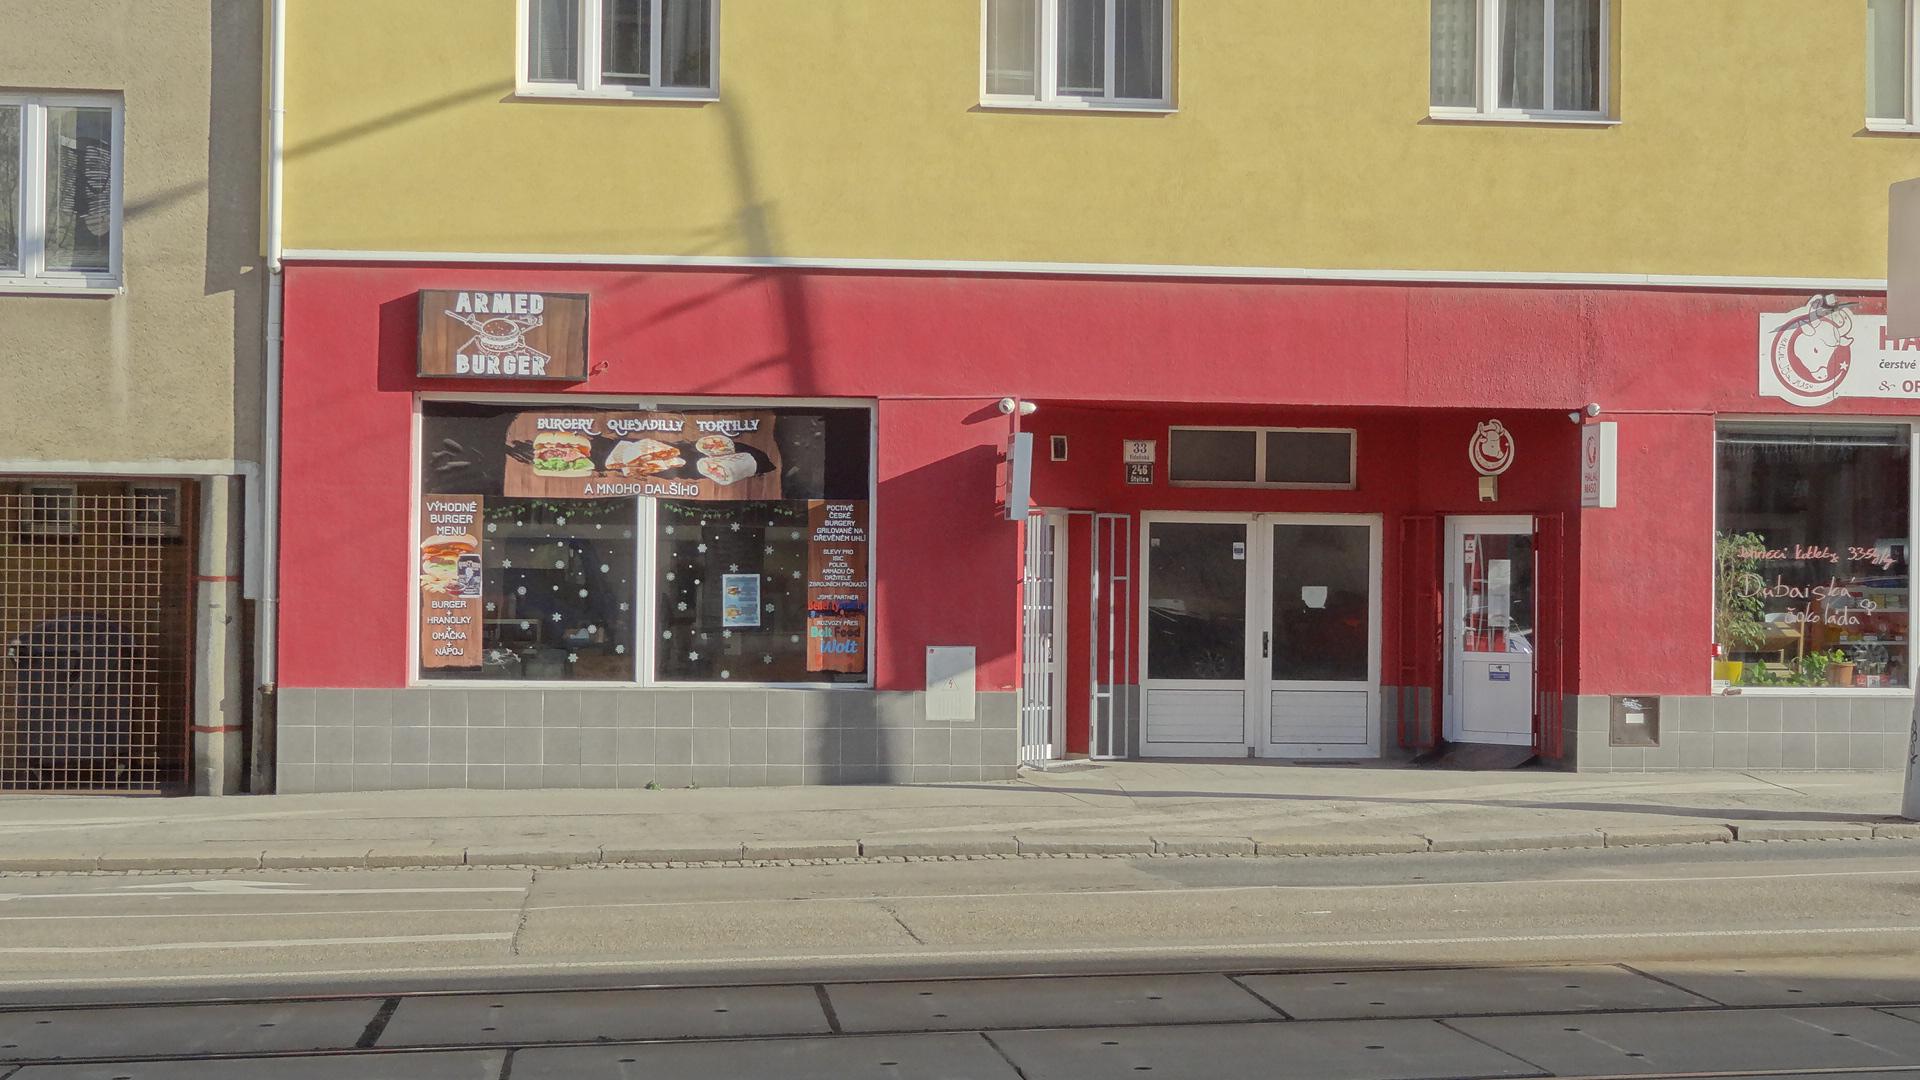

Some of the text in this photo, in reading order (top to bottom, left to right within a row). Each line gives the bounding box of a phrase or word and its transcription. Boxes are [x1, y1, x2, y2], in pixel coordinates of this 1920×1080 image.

[456, 292, 545, 315] ARMED
[456, 354, 546, 376] BURGER
[1879, 359, 1917, 369] čerstvé
[537, 418, 760, 437] BURGERY QUESADILLY TORTILLY
[1133, 443, 1147, 453] 33
[1131, 465, 1148, 475] 246
[584, 481, 699, 496] A MNOHO DALŠÍHO
[426, 501, 477, 512] VÝHODNÉ
[430, 514, 473, 524] BURGER
[829, 511, 852, 519] ČESKÉ
[436, 526, 467, 535] MENU
[432, 600, 467, 608] BURGER
[427, 616, 471, 624] HRANOLKY
[432, 630, 467, 640] OMÁČKA
[811, 626, 833, 638] Bolt
[435, 646, 464, 656] NÁPOJ
[821, 639, 858, 654] Wolt
